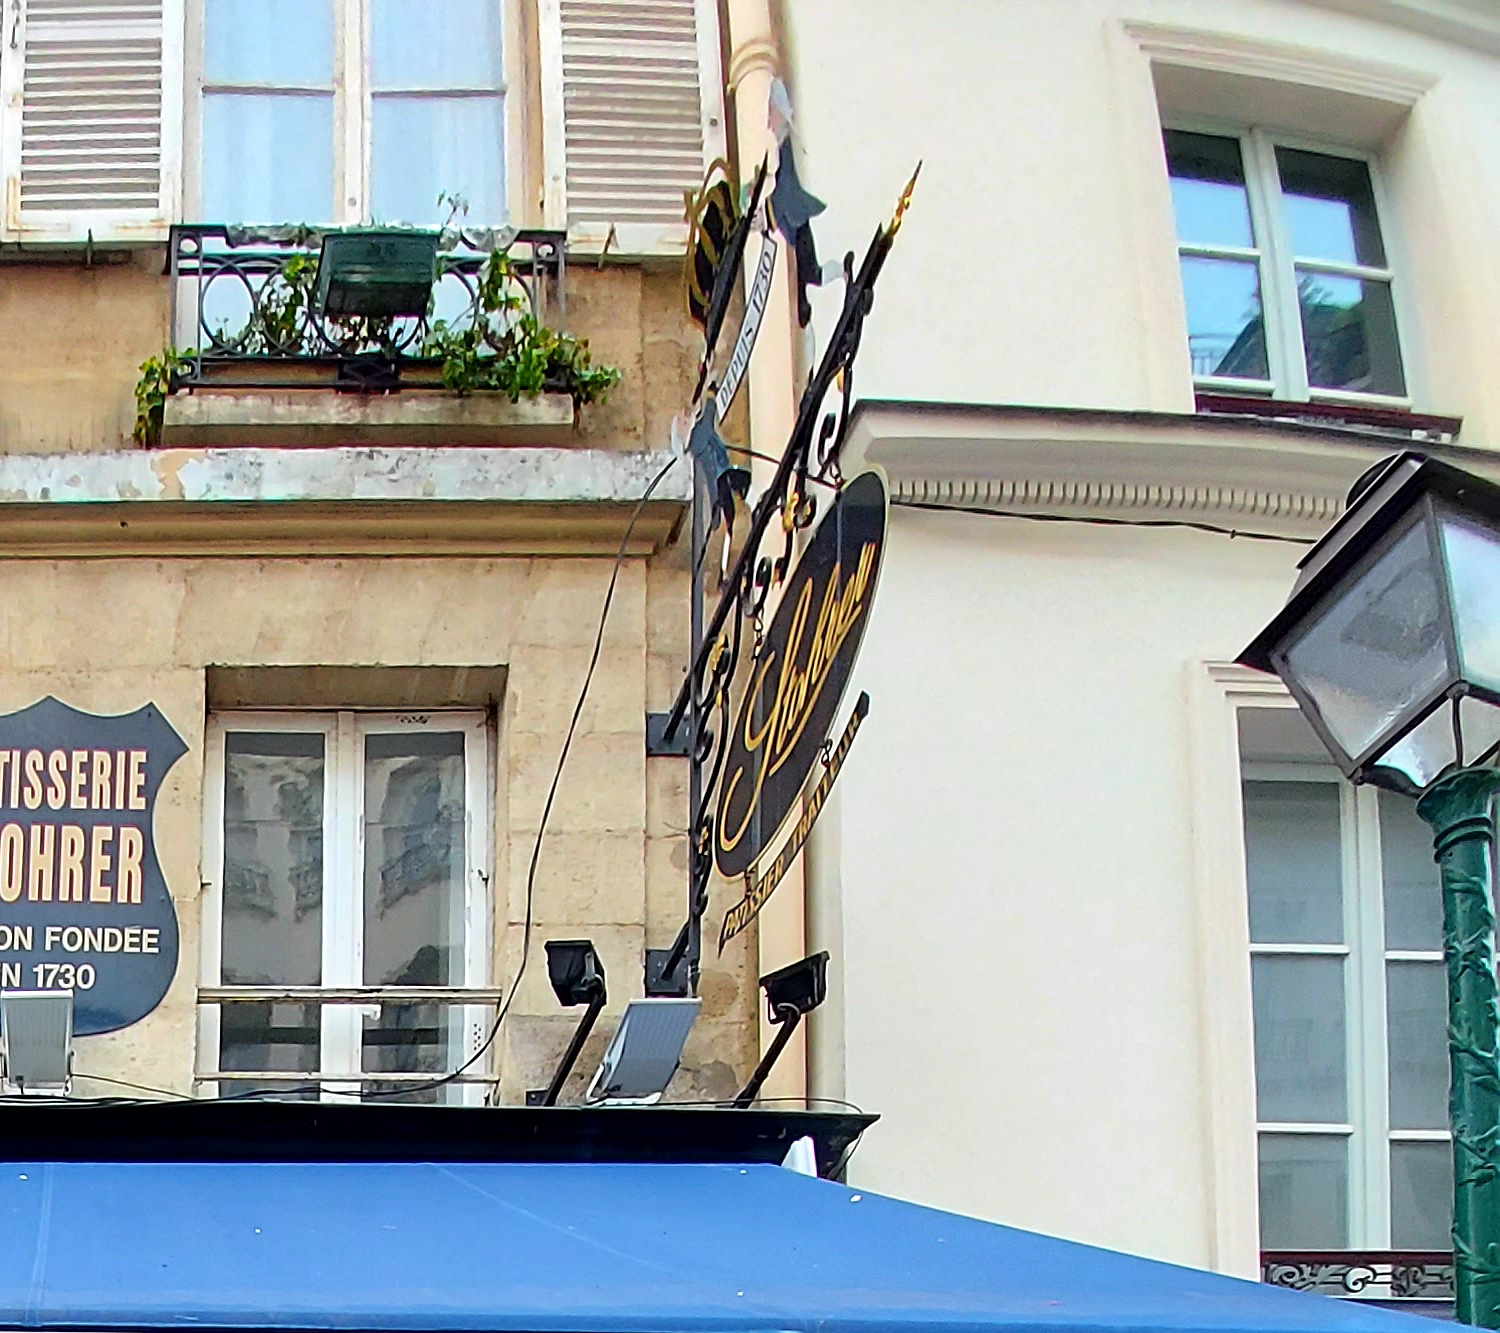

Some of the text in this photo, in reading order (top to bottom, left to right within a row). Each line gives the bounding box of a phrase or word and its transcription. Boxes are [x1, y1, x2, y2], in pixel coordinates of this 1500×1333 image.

[719, 250, 773, 408] DEPUIS 1730
[724, 710, 862, 940] PATISSIER TRAITEUR
[32, 962, 97, 990] 1730
